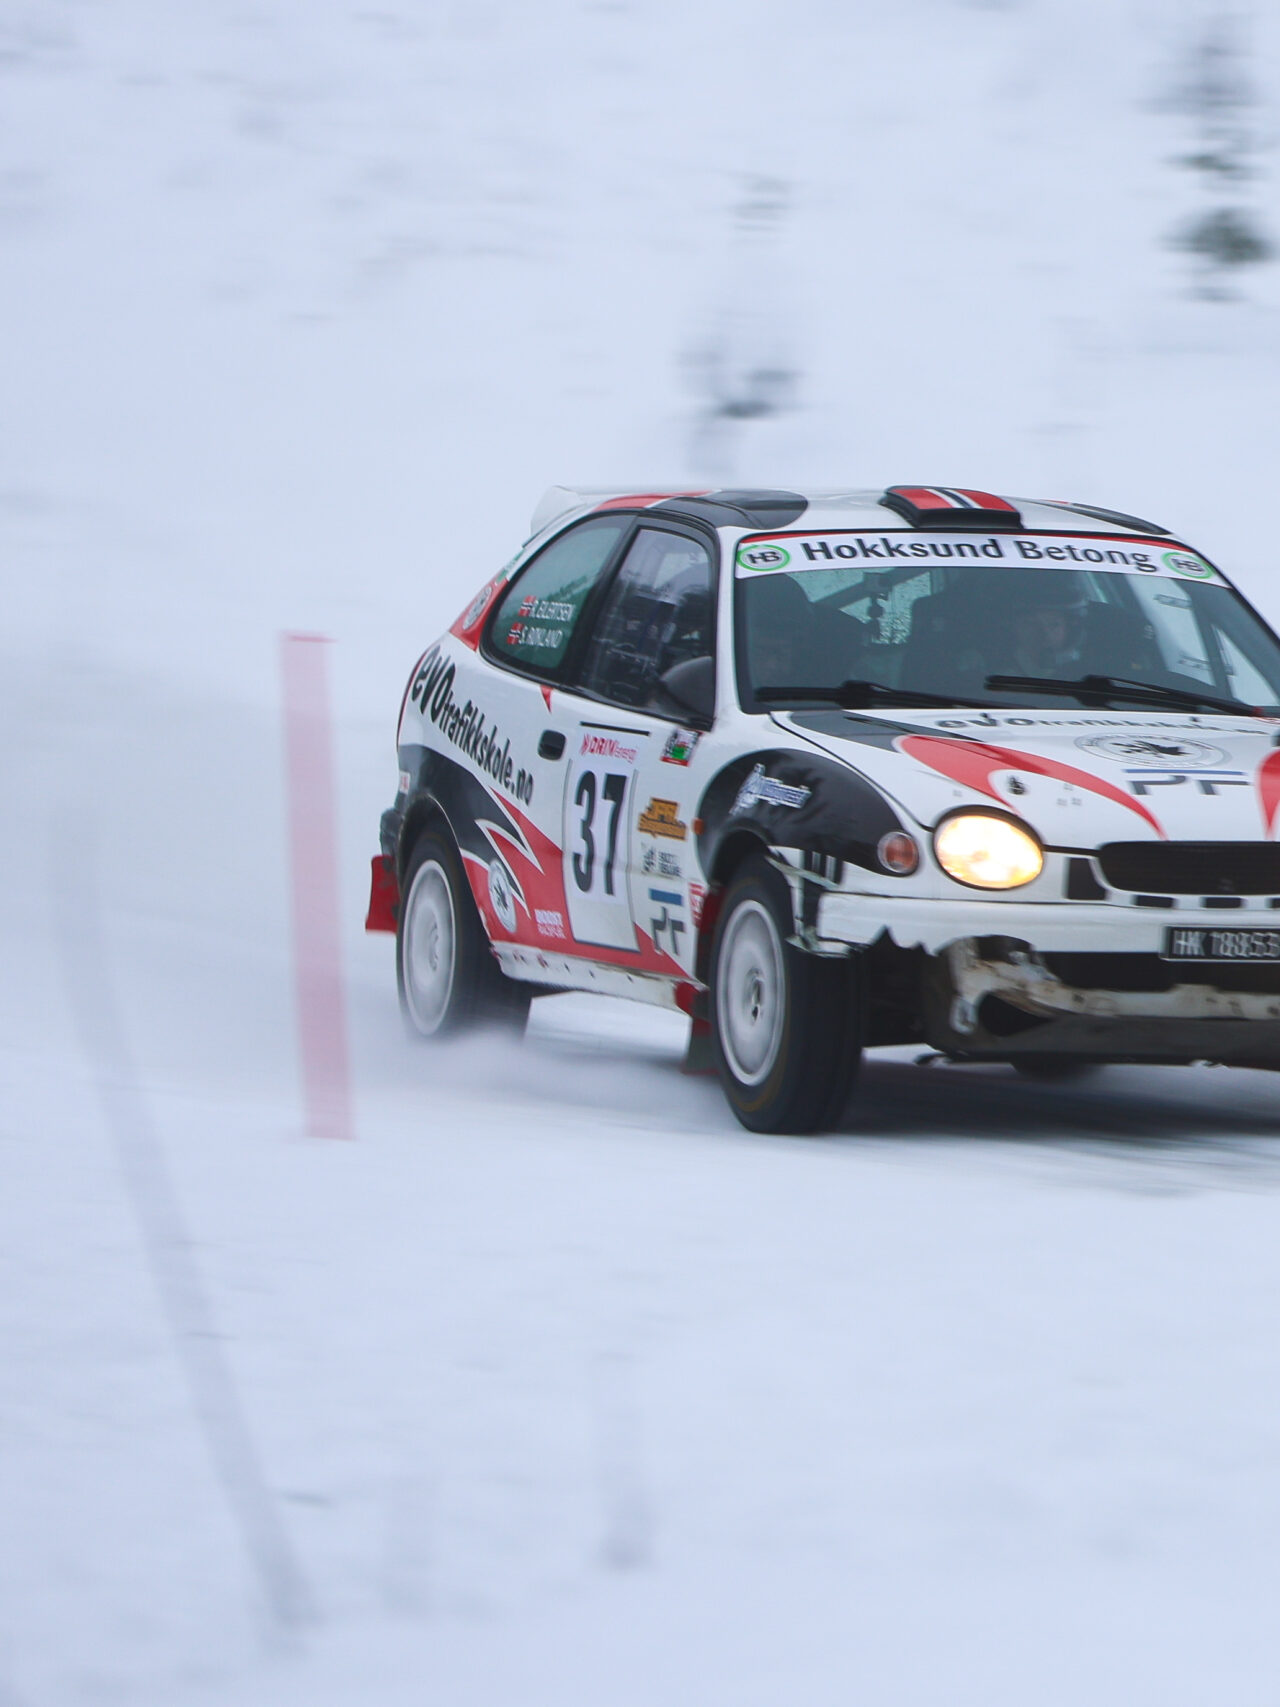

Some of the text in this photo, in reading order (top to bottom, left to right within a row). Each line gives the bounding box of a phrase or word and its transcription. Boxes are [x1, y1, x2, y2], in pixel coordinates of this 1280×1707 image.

[749, 550, 781, 565] HB
[801, 537, 1158, 573] Hokksund Betong
[1171, 557, 1206, 573] HB
[572, 769, 628, 897] 37
